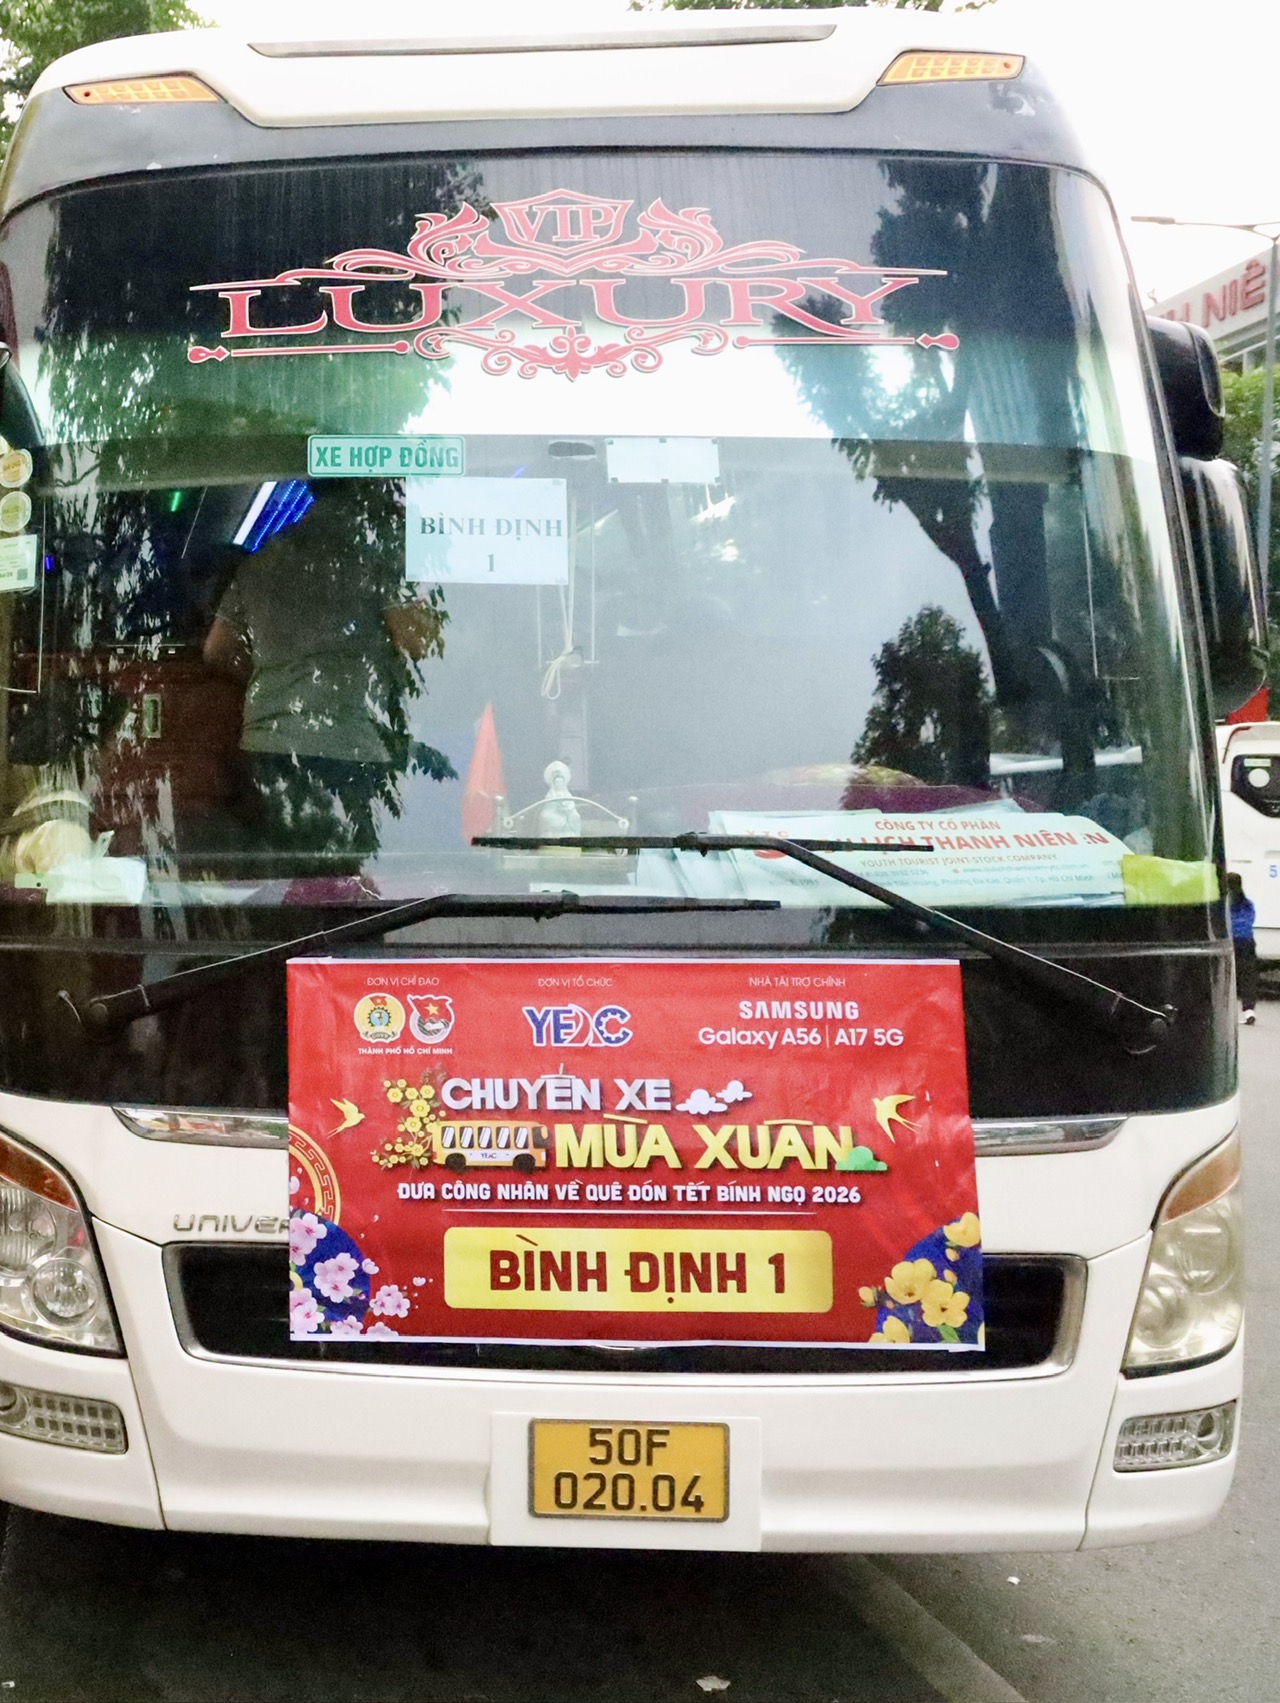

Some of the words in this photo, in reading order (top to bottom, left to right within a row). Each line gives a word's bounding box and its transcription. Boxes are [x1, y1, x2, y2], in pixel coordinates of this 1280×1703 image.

[504, 204, 617, 241] VIP
[217, 277, 921, 338] LUXURY
[315, 446, 342, 467] XE
[349, 445, 393, 472] HỢP
[400, 439, 459, 467] ĐỒNG
[419, 512, 486, 536] BÌNH
[487, 553, 496, 573] 1
[874, 819, 915, 831] CÔNG
[918, 821, 934, 831] TY
[920, 835, 1011, 850] THANH
[1013, 829, 1079, 848] NIÊN
[860, 859, 896, 868] YOUTH
[899, 857, 939, 867] TOURIST
[1006, 853, 1058, 863] COMPANY
[749, 976, 772, 987] NHÀ
[738, 1000, 860, 1020] SAMSUNG
[358, 1046, 384, 1055] THÀNH
[385, 1046, 401, 1055] PHỐ
[417, 1046, 431, 1055] CHÍ
[432, 1047, 453, 1055] MINH
[698, 1027, 778, 1050] Galaxy
[781, 1027, 822, 1045] A56
[834, 1028, 868, 1046] A17
[873, 1028, 904, 1047] 5G
[441, 1063, 601, 1111] CHUYẾN
[614, 1078, 672, 1111] XE
[554, 1113, 682, 1169] MÙA
[693, 1118, 853, 1171] XUÂN
[397, 1182, 436, 1200] ĐƯA
[441, 1180, 491, 1200] CÔNG
[497, 1181, 549, 1200] NHÂN
[555, 1179, 583, 1200] VỀ
[586, 1181, 623, 1202] QUÊ
[627, 1179, 667, 1202] ĐÓN
[673, 1180, 710, 1202] TẾT
[717, 1180, 761, 1202] BÍNH
[767, 1185, 806, 1206] NGỌ
[811, 1185, 862, 1203] 2026
[489, 1234, 608, 1293] BÌNH
[624, 1251, 747, 1304] ĐỊNH
[768, 1252, 786, 1294] 1
[588, 1427, 671, 1467] 50F
[553, 1471, 705, 1513] 020.04
